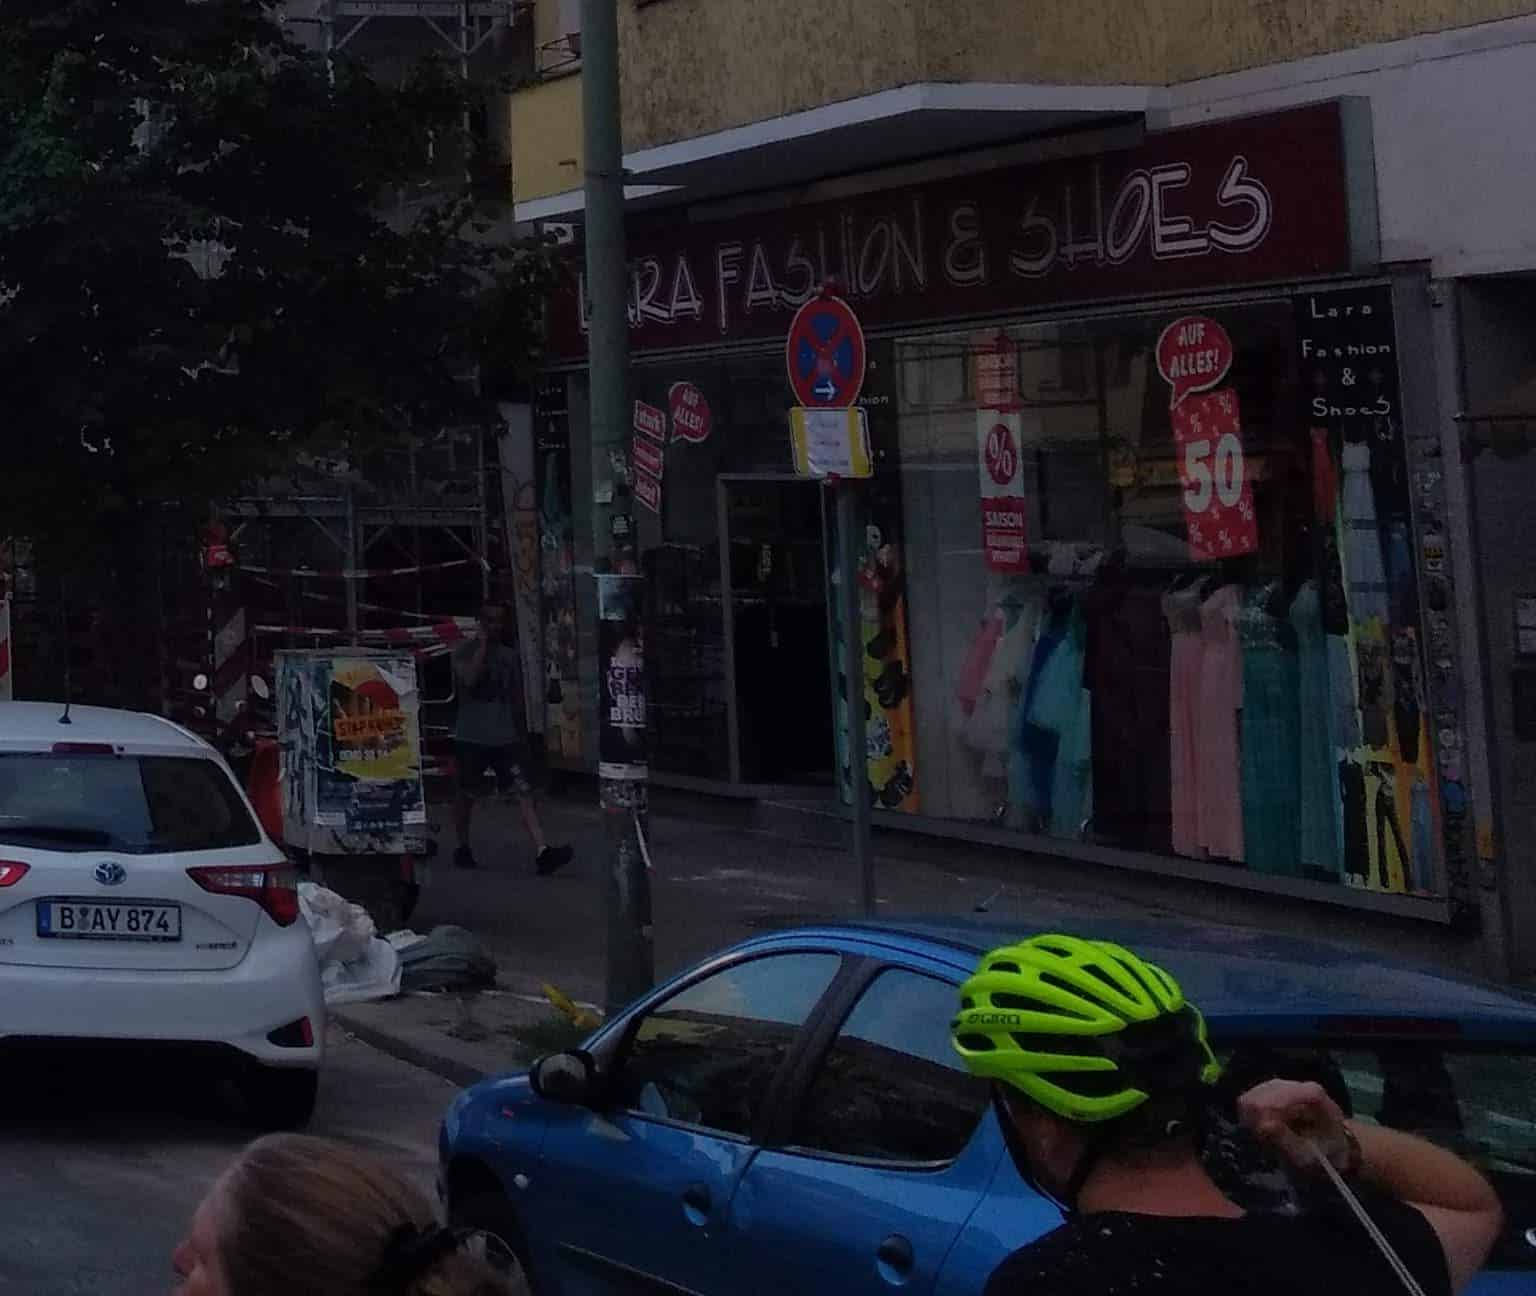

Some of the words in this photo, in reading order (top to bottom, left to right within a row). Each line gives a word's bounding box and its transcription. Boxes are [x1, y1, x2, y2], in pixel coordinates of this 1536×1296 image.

[578, 252, 703, 329] LRA
[944, 202, 988, 288] &
[1008, 154, 1273, 279] SHOES
[1310, 296, 1374, 320] Lara
[1178, 322, 1206, 348] AUF
[1302, 337, 1392, 359] Fashion
[1169, 348, 1220, 379] ALLES!
[1341, 367, 1358, 386] &
[1184, 432, 1244, 513] 50
[61, 907, 74, 929] B
[91, 908, 121, 931] AY
[128, 910, 169, 933] 874
